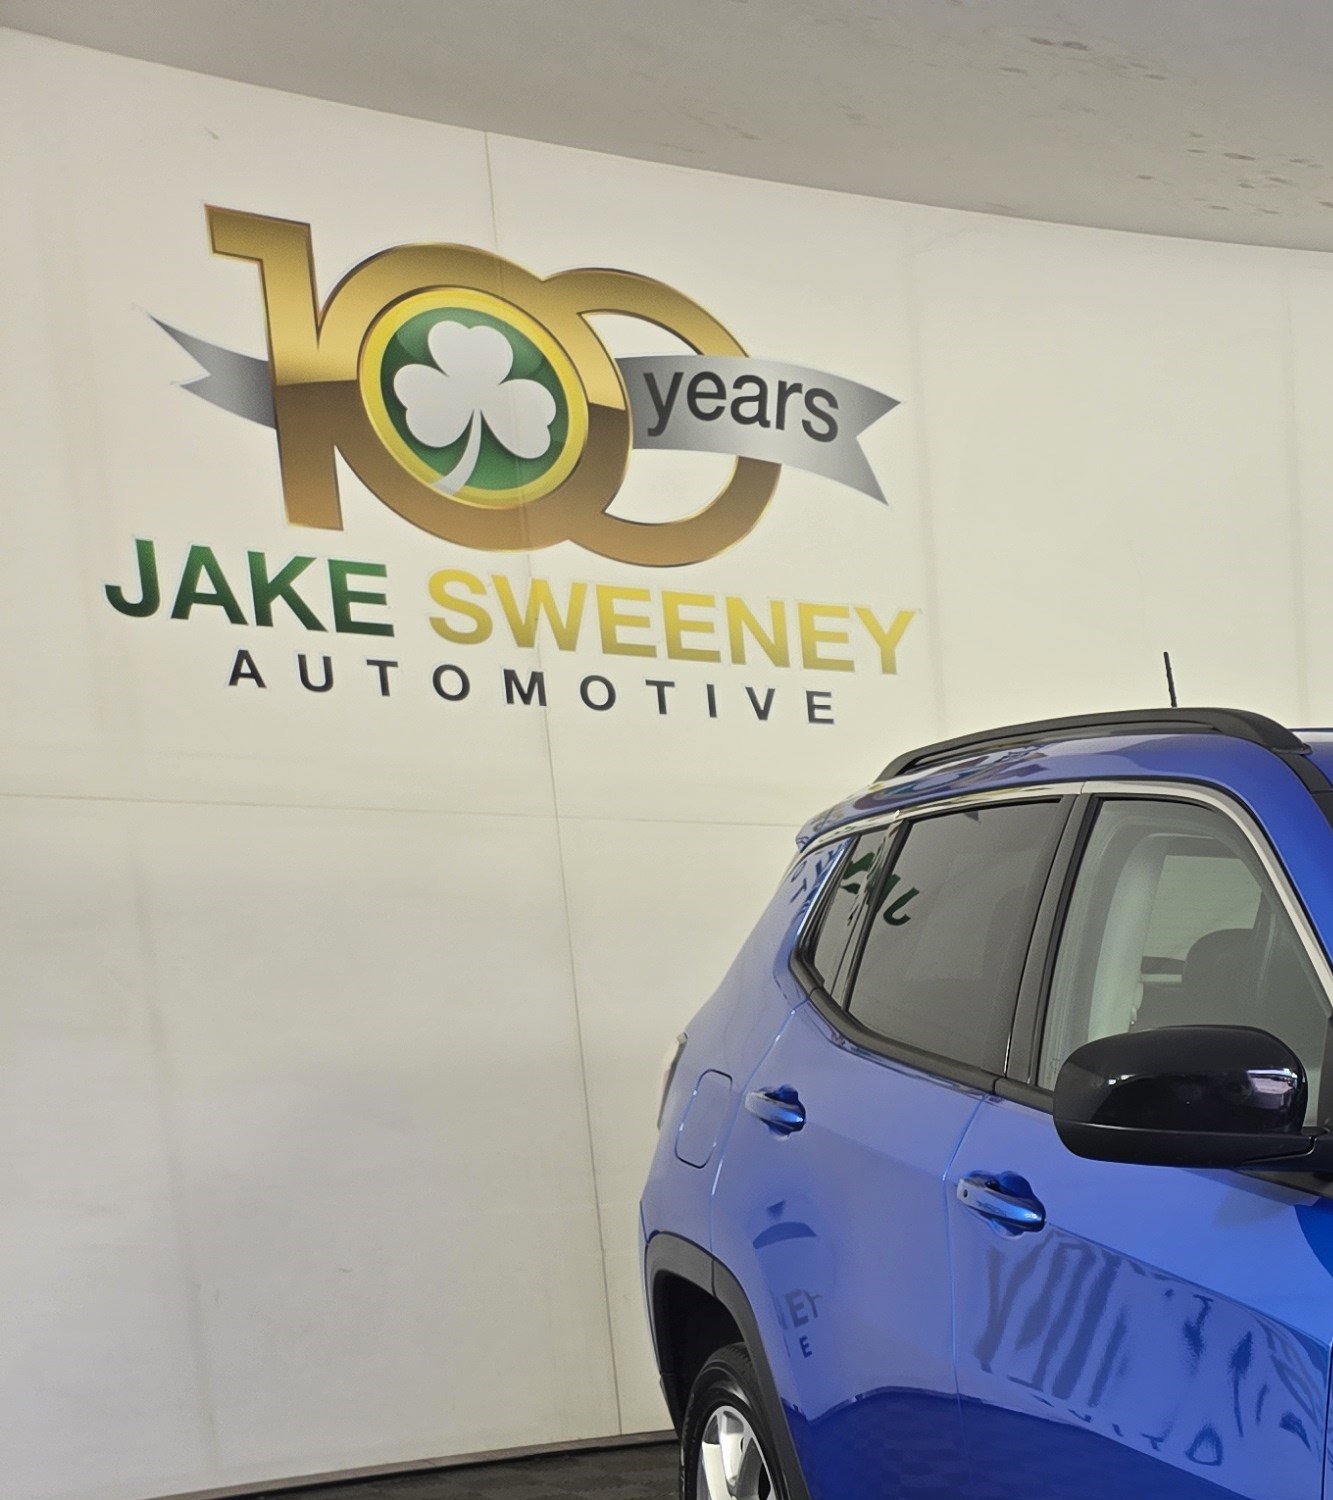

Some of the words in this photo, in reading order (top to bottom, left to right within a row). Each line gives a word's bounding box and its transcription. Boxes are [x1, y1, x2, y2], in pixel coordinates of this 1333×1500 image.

[204, 203, 782, 568] 100
[644, 370, 840, 443] years
[105, 537, 396, 638] JAKE
[428, 568, 916, 676] SWEENEY
[227, 649, 836, 725] AUTOMOTIVE
